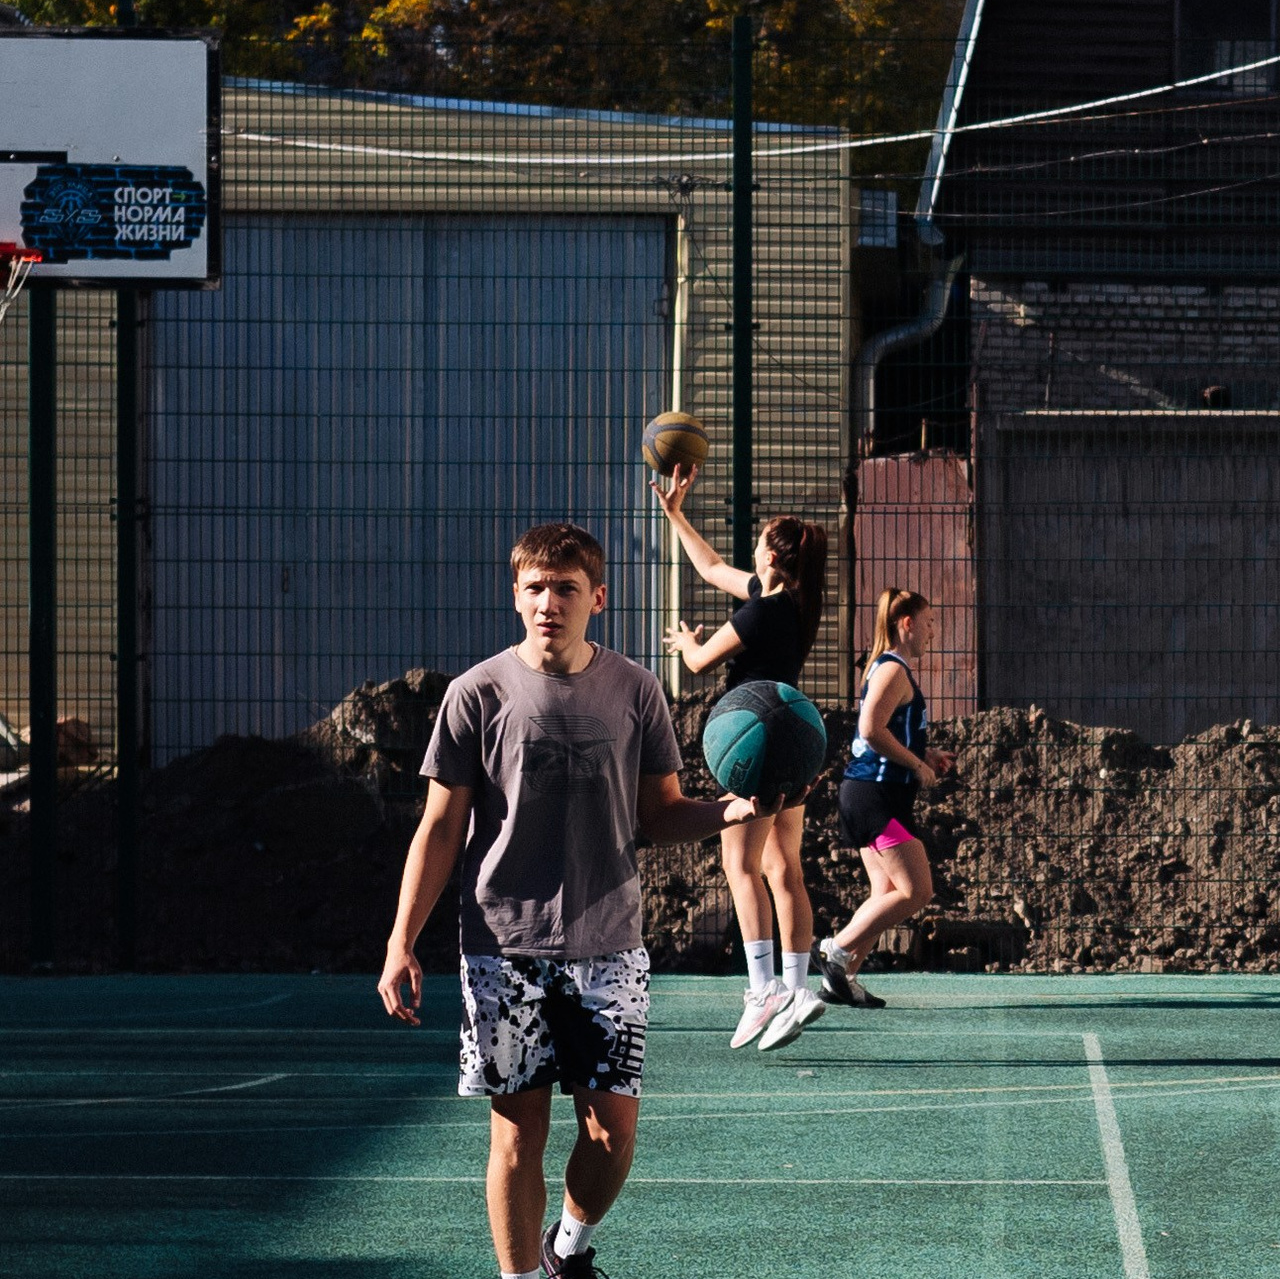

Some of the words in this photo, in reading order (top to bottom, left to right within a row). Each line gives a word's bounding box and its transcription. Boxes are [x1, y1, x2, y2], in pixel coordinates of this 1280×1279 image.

[114, 187, 173, 204] СПОРТ
[114, 206, 186, 223] НОРМА
[114, 224, 185, 241] ЖИЗНИ
